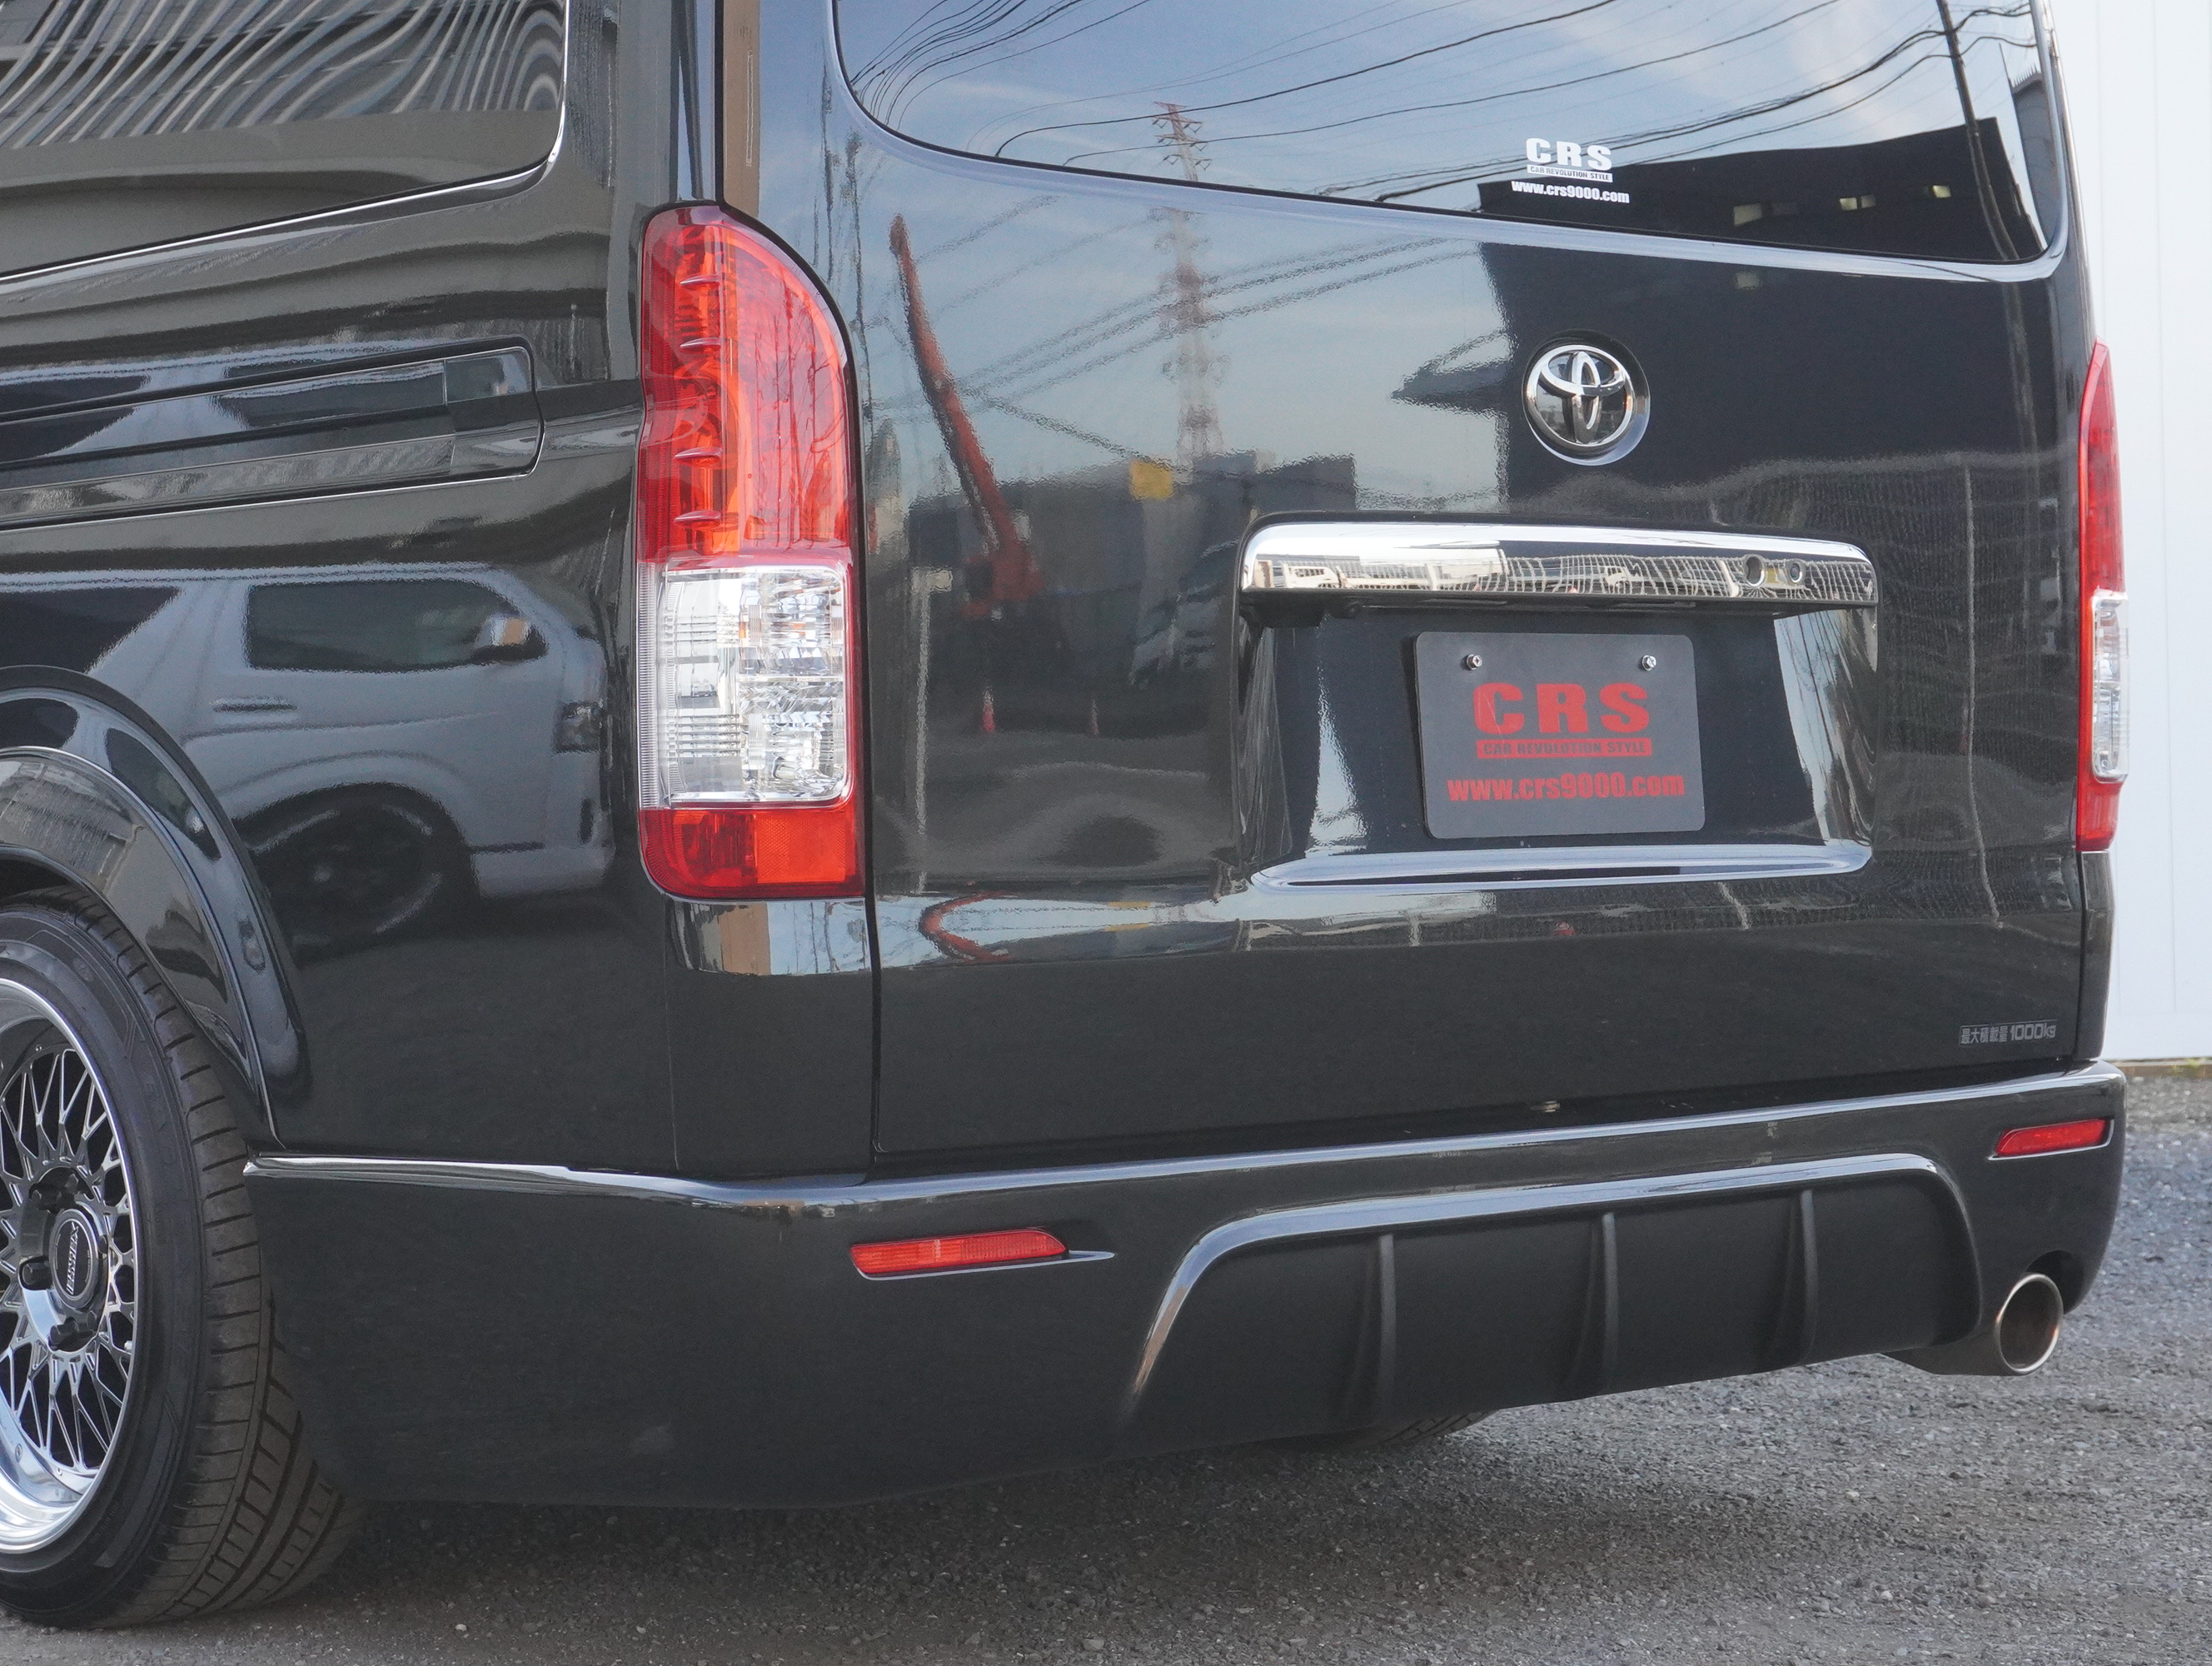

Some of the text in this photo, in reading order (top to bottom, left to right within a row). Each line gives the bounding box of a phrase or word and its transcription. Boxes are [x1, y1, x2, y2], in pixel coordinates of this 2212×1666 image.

[1526, 137, 1612, 171] CRS
[1546, 167, 1588, 178] REVOLUTION
[1590, 172, 1610, 181] STYLE
[1512, 181, 1630, 203] www.crs9000.com
[1473, 682, 1650, 734] CRS
[1483, 740, 1647, 756] CAR REVOLUTION STYLE
[1447, 772, 1685, 801] www.crs9000.com
[1960, 1023, 2057, 1044] 最大積載量 1000kg
